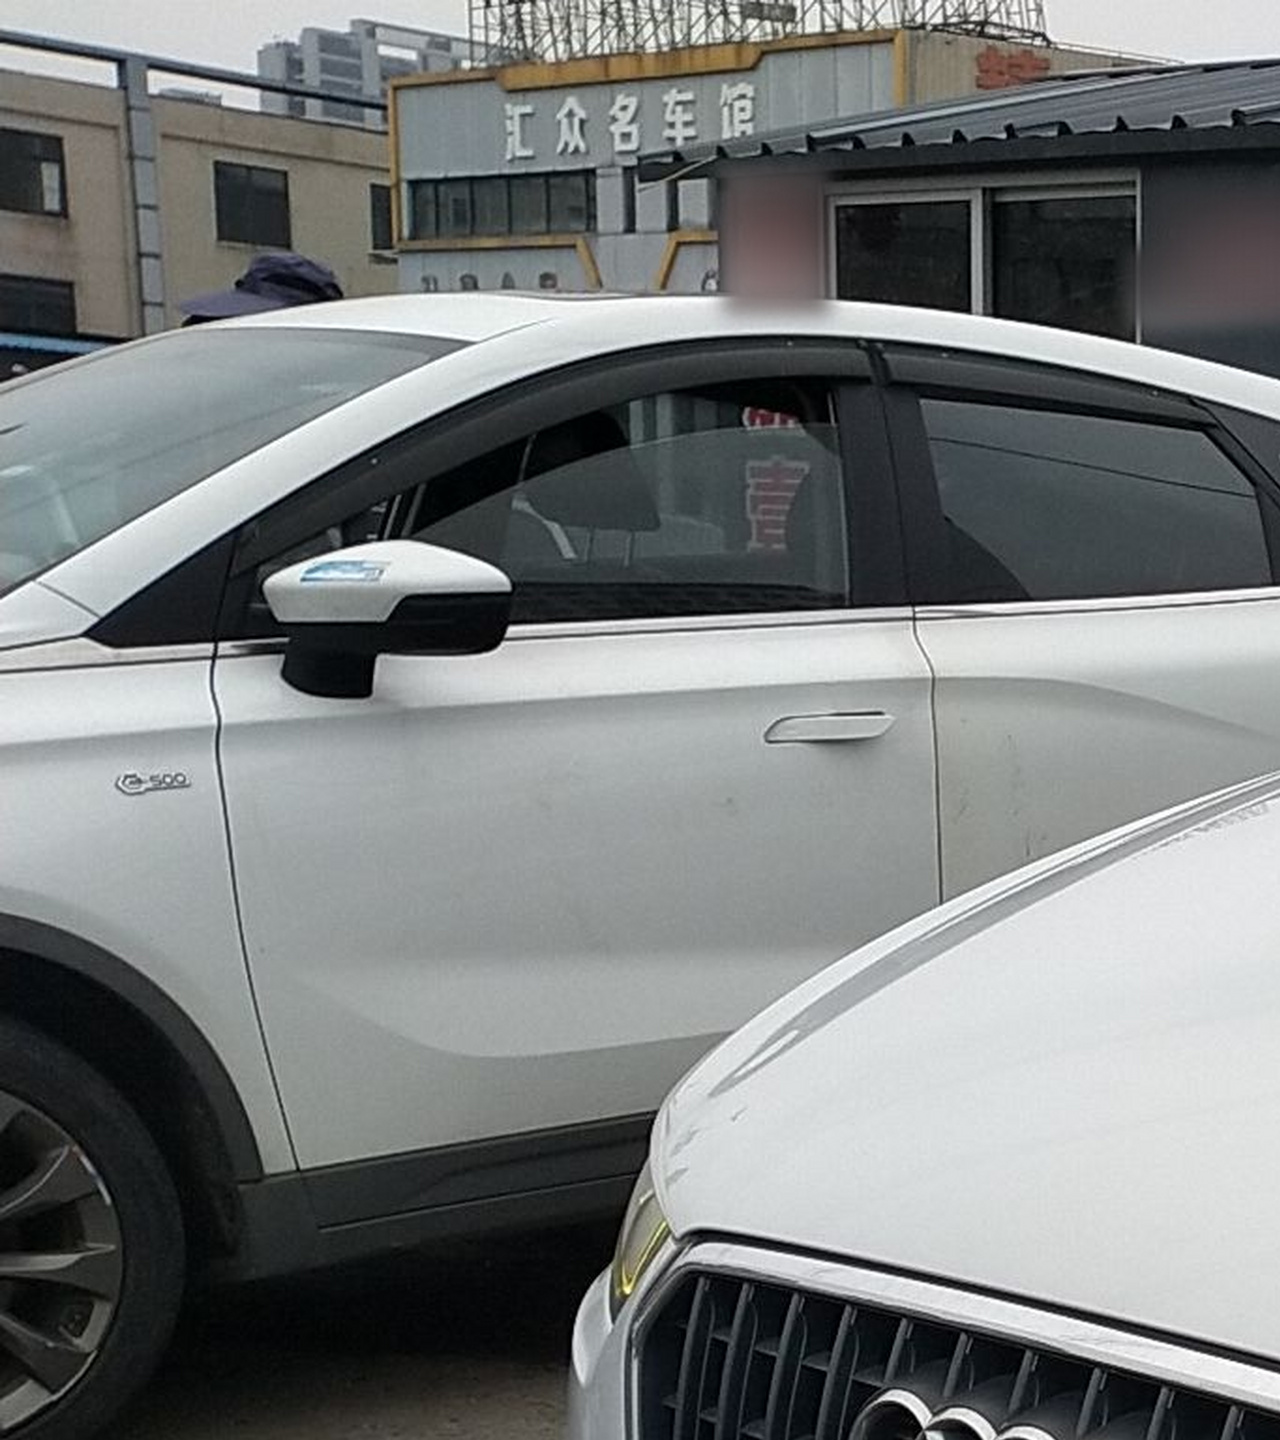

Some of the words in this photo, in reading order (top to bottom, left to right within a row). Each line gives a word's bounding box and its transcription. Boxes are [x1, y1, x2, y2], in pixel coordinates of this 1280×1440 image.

[504, 82, 755, 161] 汇众名车馆
